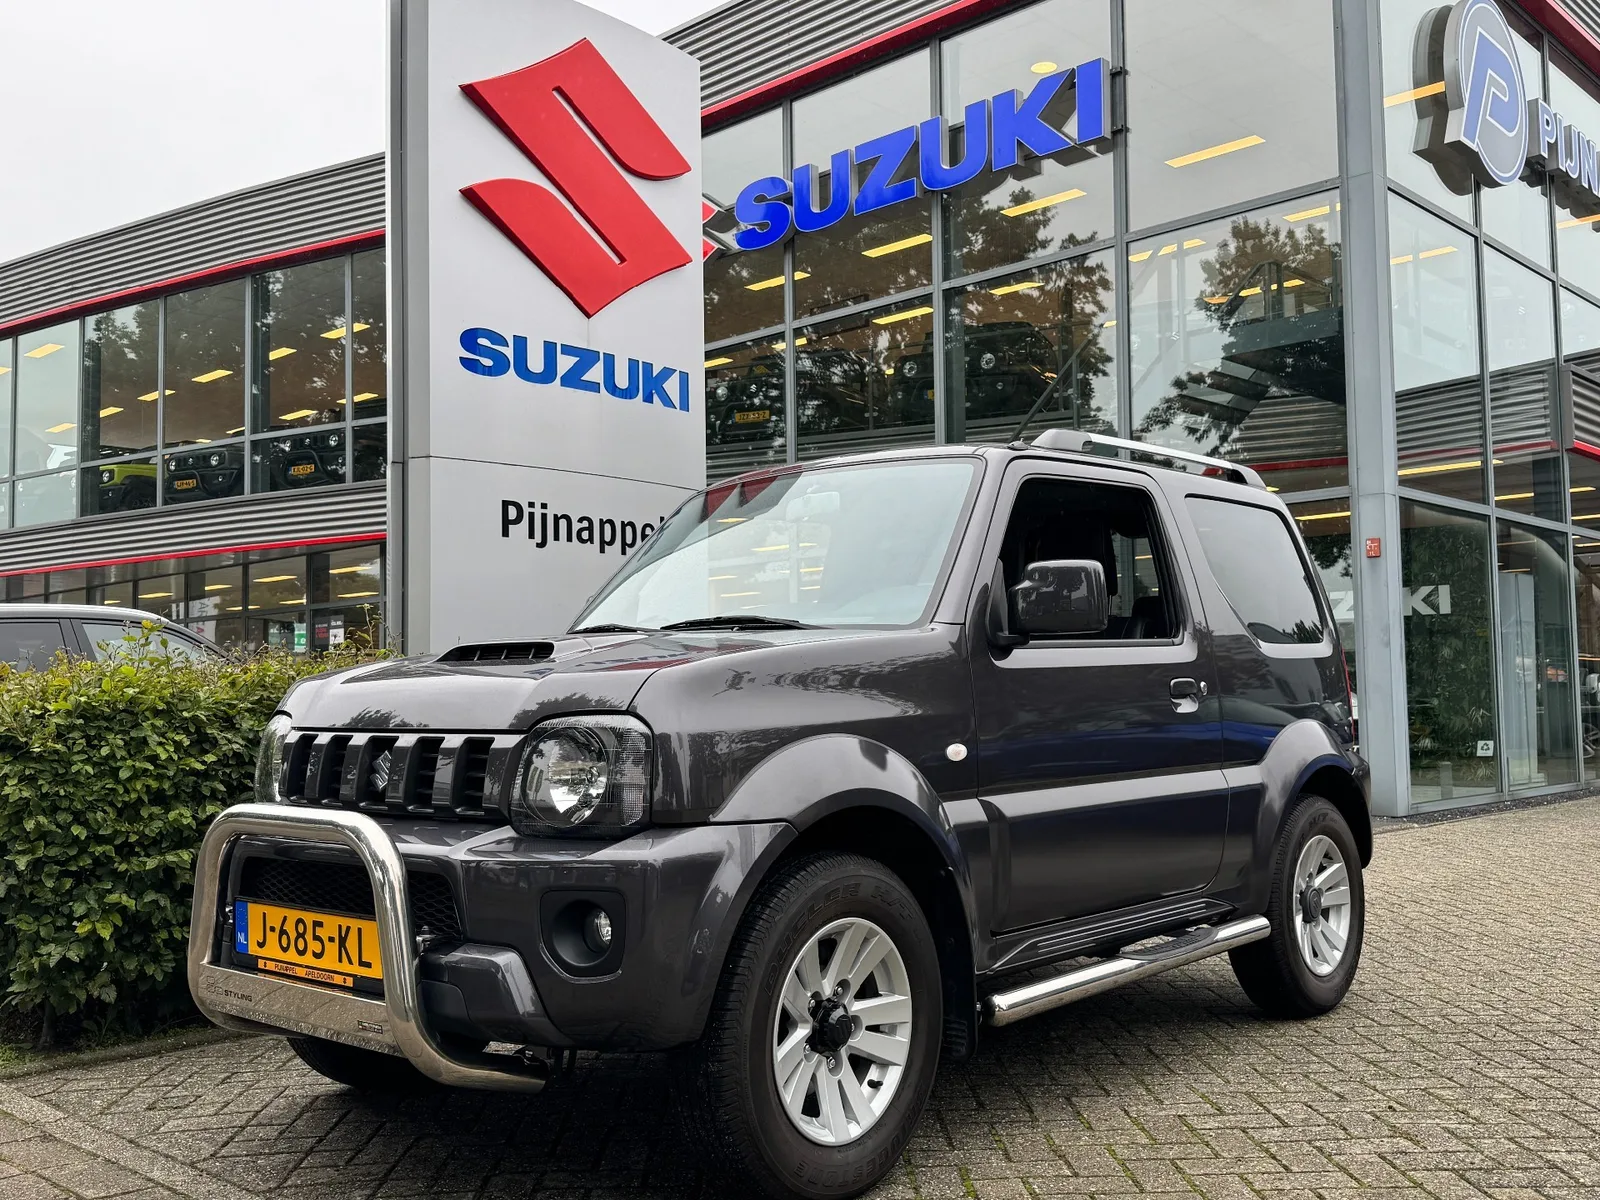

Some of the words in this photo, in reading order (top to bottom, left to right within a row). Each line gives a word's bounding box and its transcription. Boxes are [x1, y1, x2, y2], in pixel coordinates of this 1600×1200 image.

[735, 57, 1103, 250] SUZUKI
[1538, 97, 1600, 198] PIJN
[459, 327, 690, 412] SUZUKI
[501, 499, 665, 555] Pijnappe
[237, 931, 248, 944] NL
[256, 911, 373, 969] J-685-KL
[224, 989, 253, 1002] STYLING
[304, 970, 335, 982] APELDOORN
